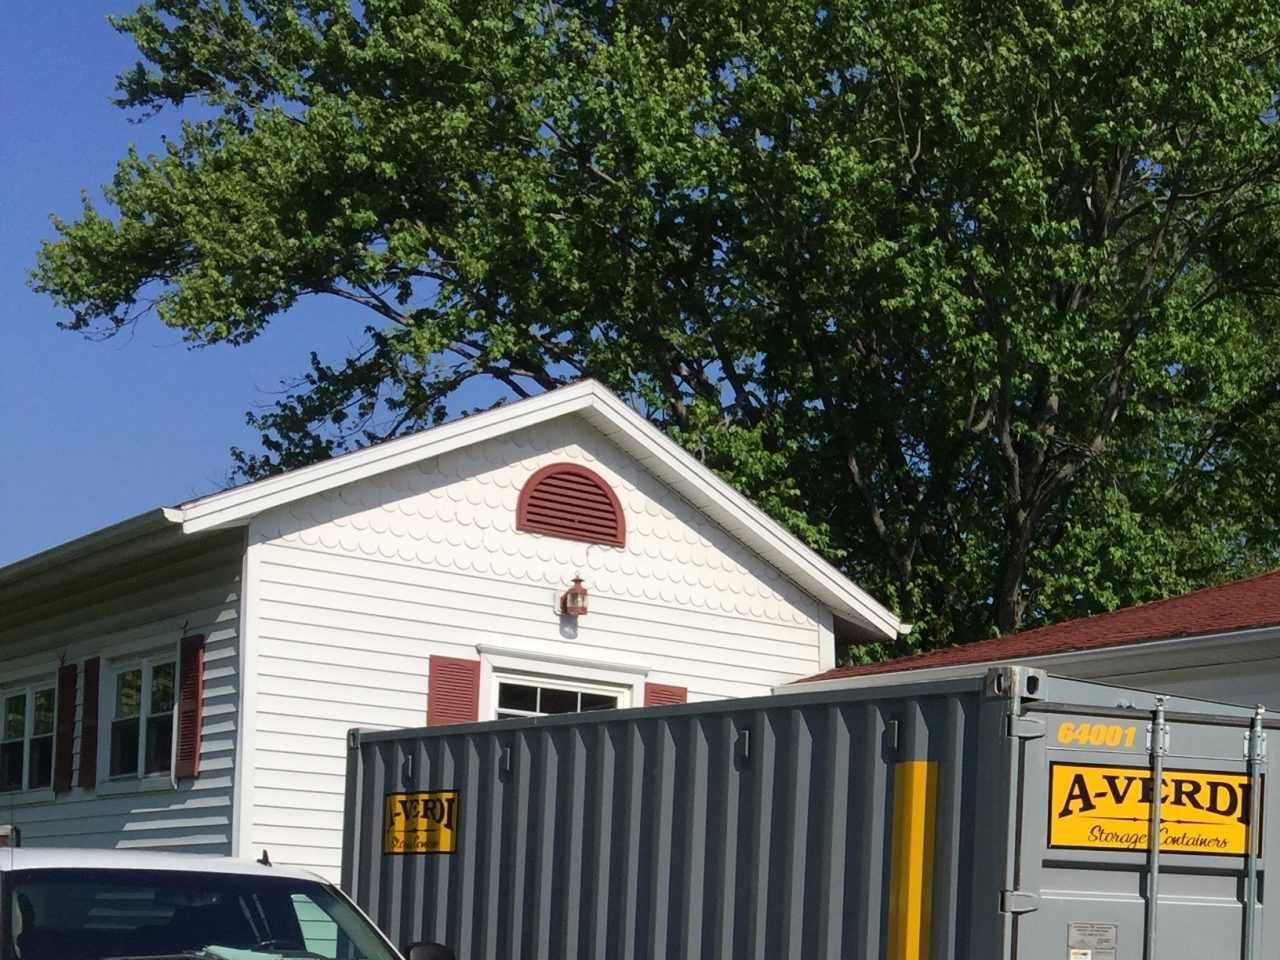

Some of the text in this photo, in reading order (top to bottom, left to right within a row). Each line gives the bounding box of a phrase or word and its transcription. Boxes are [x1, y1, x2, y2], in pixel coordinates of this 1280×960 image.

[1057, 722, 1137, 748] 64001
[1087, 824, 1229, 849] Storage Containers
